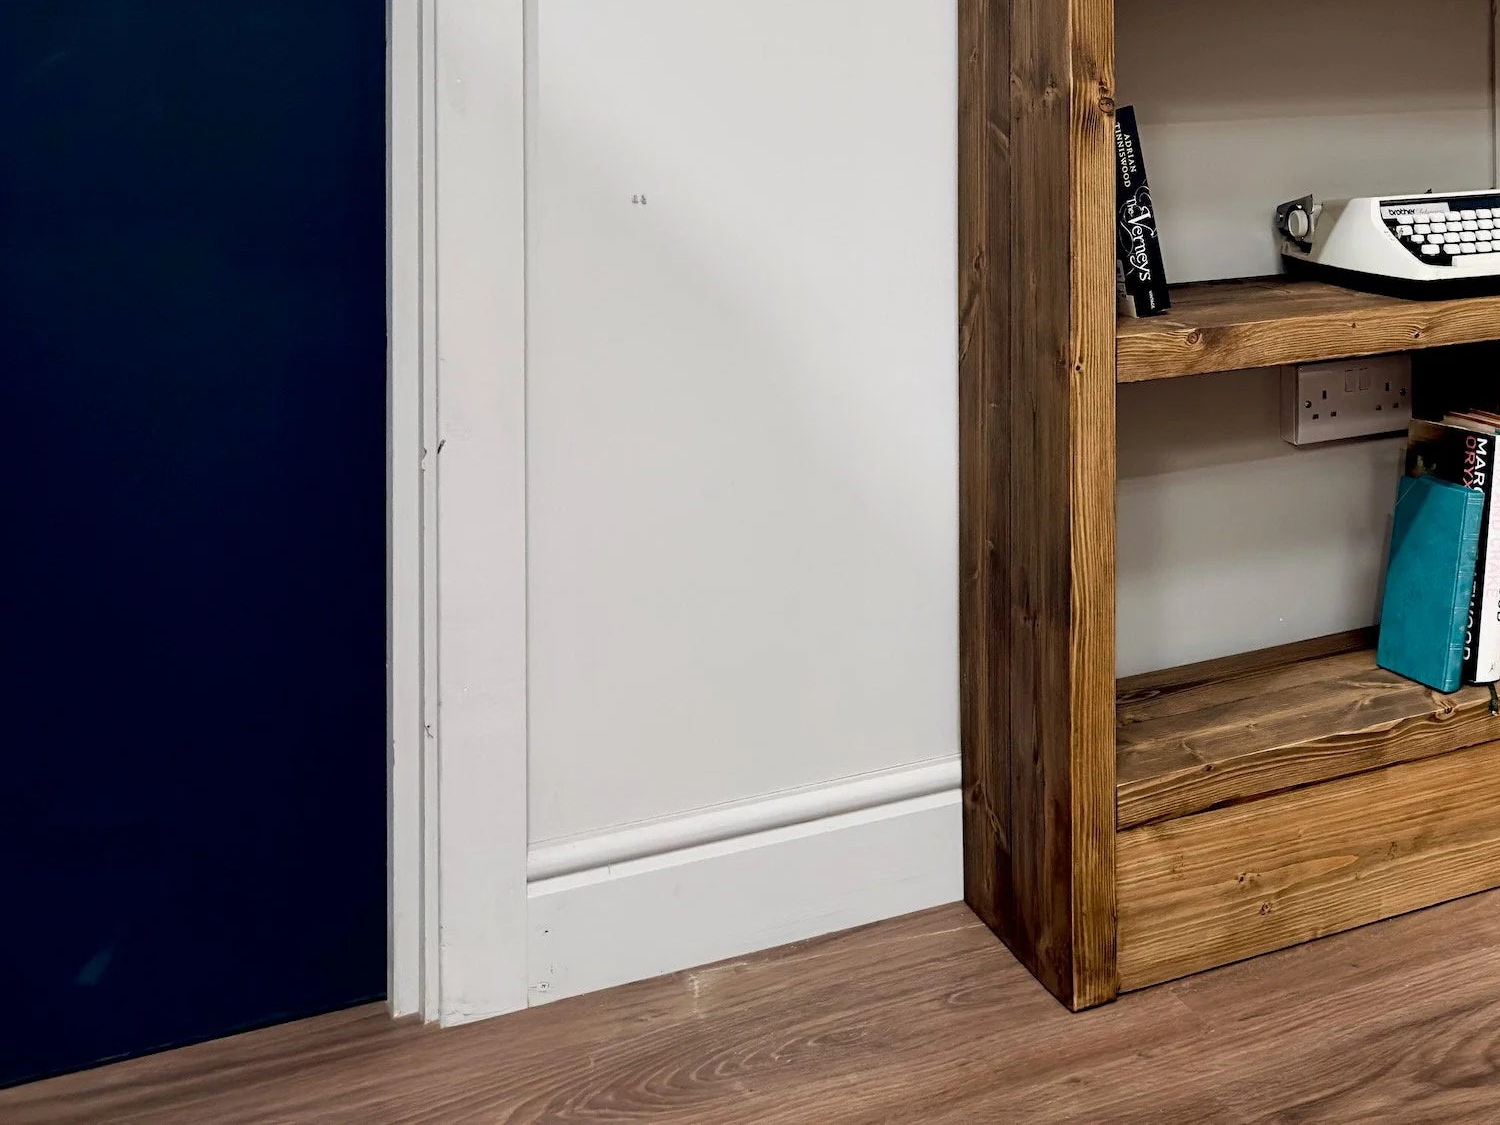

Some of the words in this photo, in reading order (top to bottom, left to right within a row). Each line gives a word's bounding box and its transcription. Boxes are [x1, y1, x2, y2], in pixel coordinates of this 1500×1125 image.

[1114, 121, 1132, 188] TINNISWOOD
[1123, 133, 1137, 173] ADRIAN
[1126, 195, 1138, 217] The
[1388, 208, 1415, 216] brother
[1127, 206, 1155, 282] Verneys
[1462, 435, 1478, 490] ORYX
